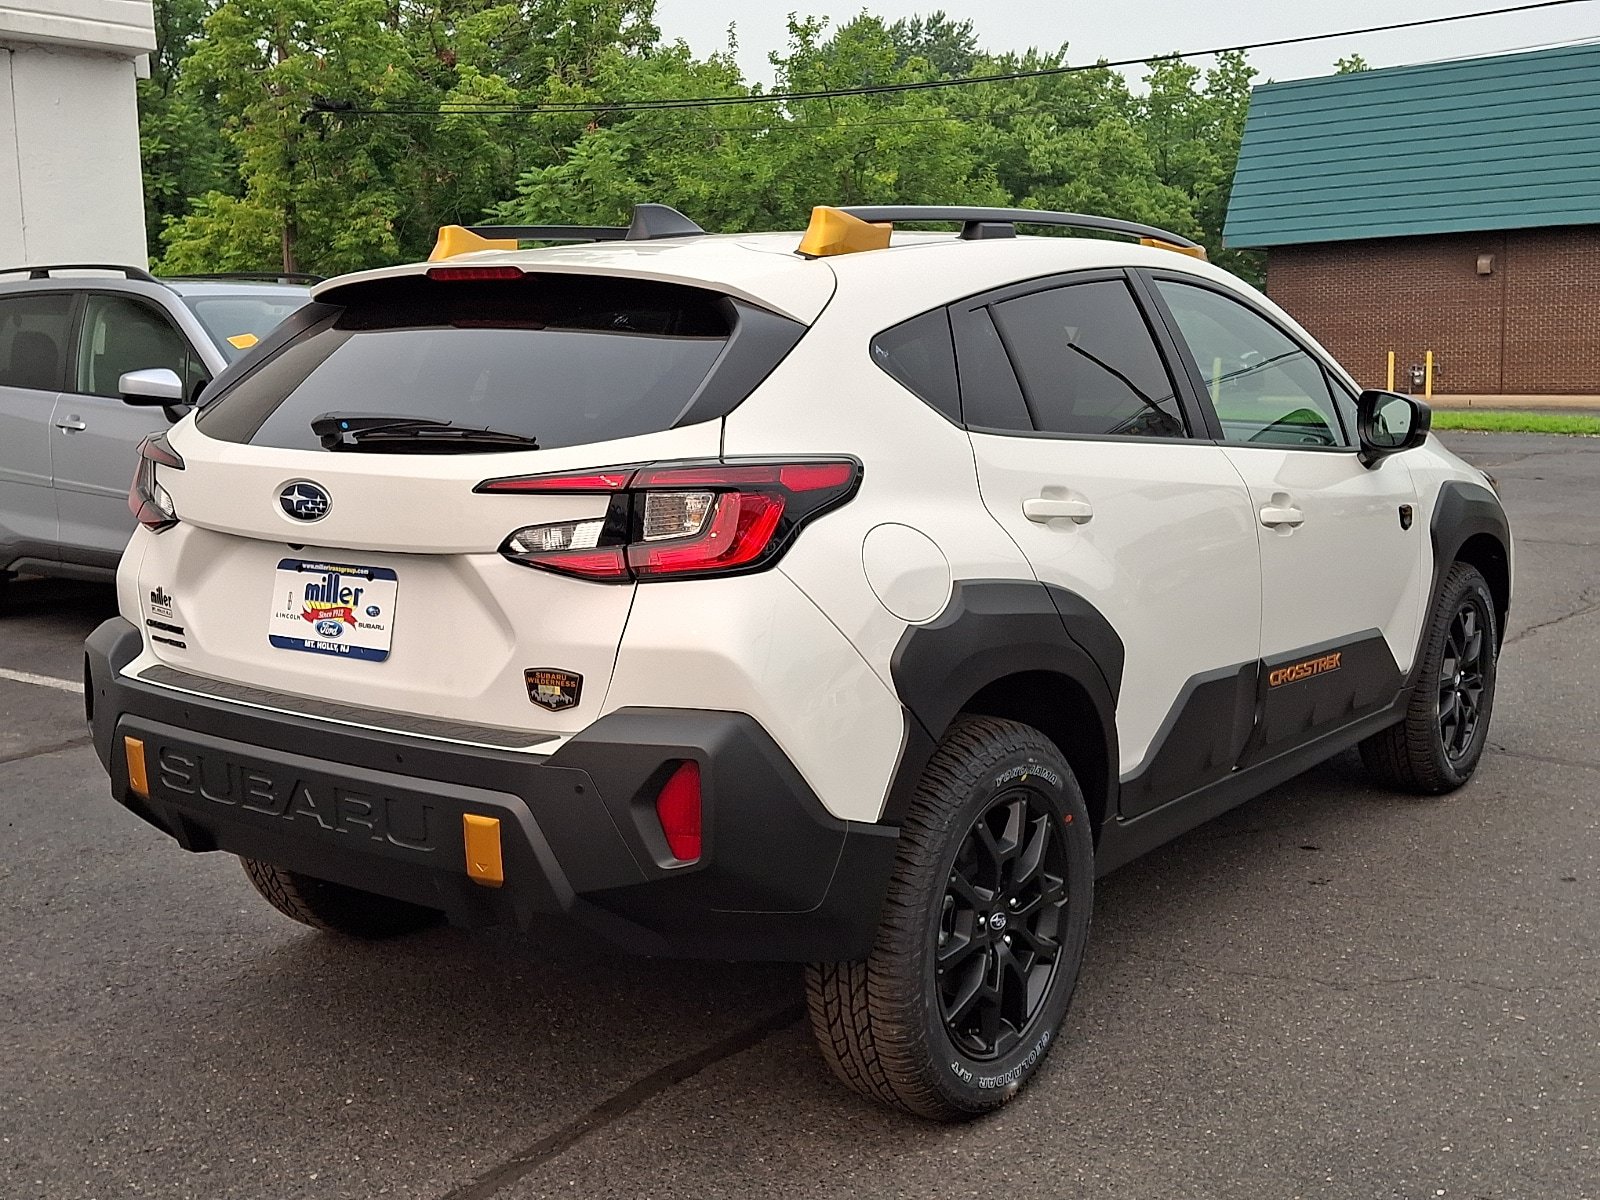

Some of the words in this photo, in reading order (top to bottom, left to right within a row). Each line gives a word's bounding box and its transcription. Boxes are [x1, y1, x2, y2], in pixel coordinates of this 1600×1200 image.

[150, 586, 172, 608] miller
[305, 573, 364, 606] miller
[275, 611, 301, 621] LINCOLN
[320, 621, 339, 636] Ford
[358, 622, 385, 631] SUBARU
[304, 639, 316, 649] MT.
[316, 641, 339, 653] HOLLY,
[340, 644, 350, 653] NJ
[535, 672, 567, 681] SUBARU
[1269, 652, 1342, 687] CROSSTREK
[527, 676, 576, 688] WILDERNESS
[158, 745, 436, 853] SUBARU
[979, 1030, 1051, 1089] GEOLANDAR
[951, 1060, 973, 1083] A/T
